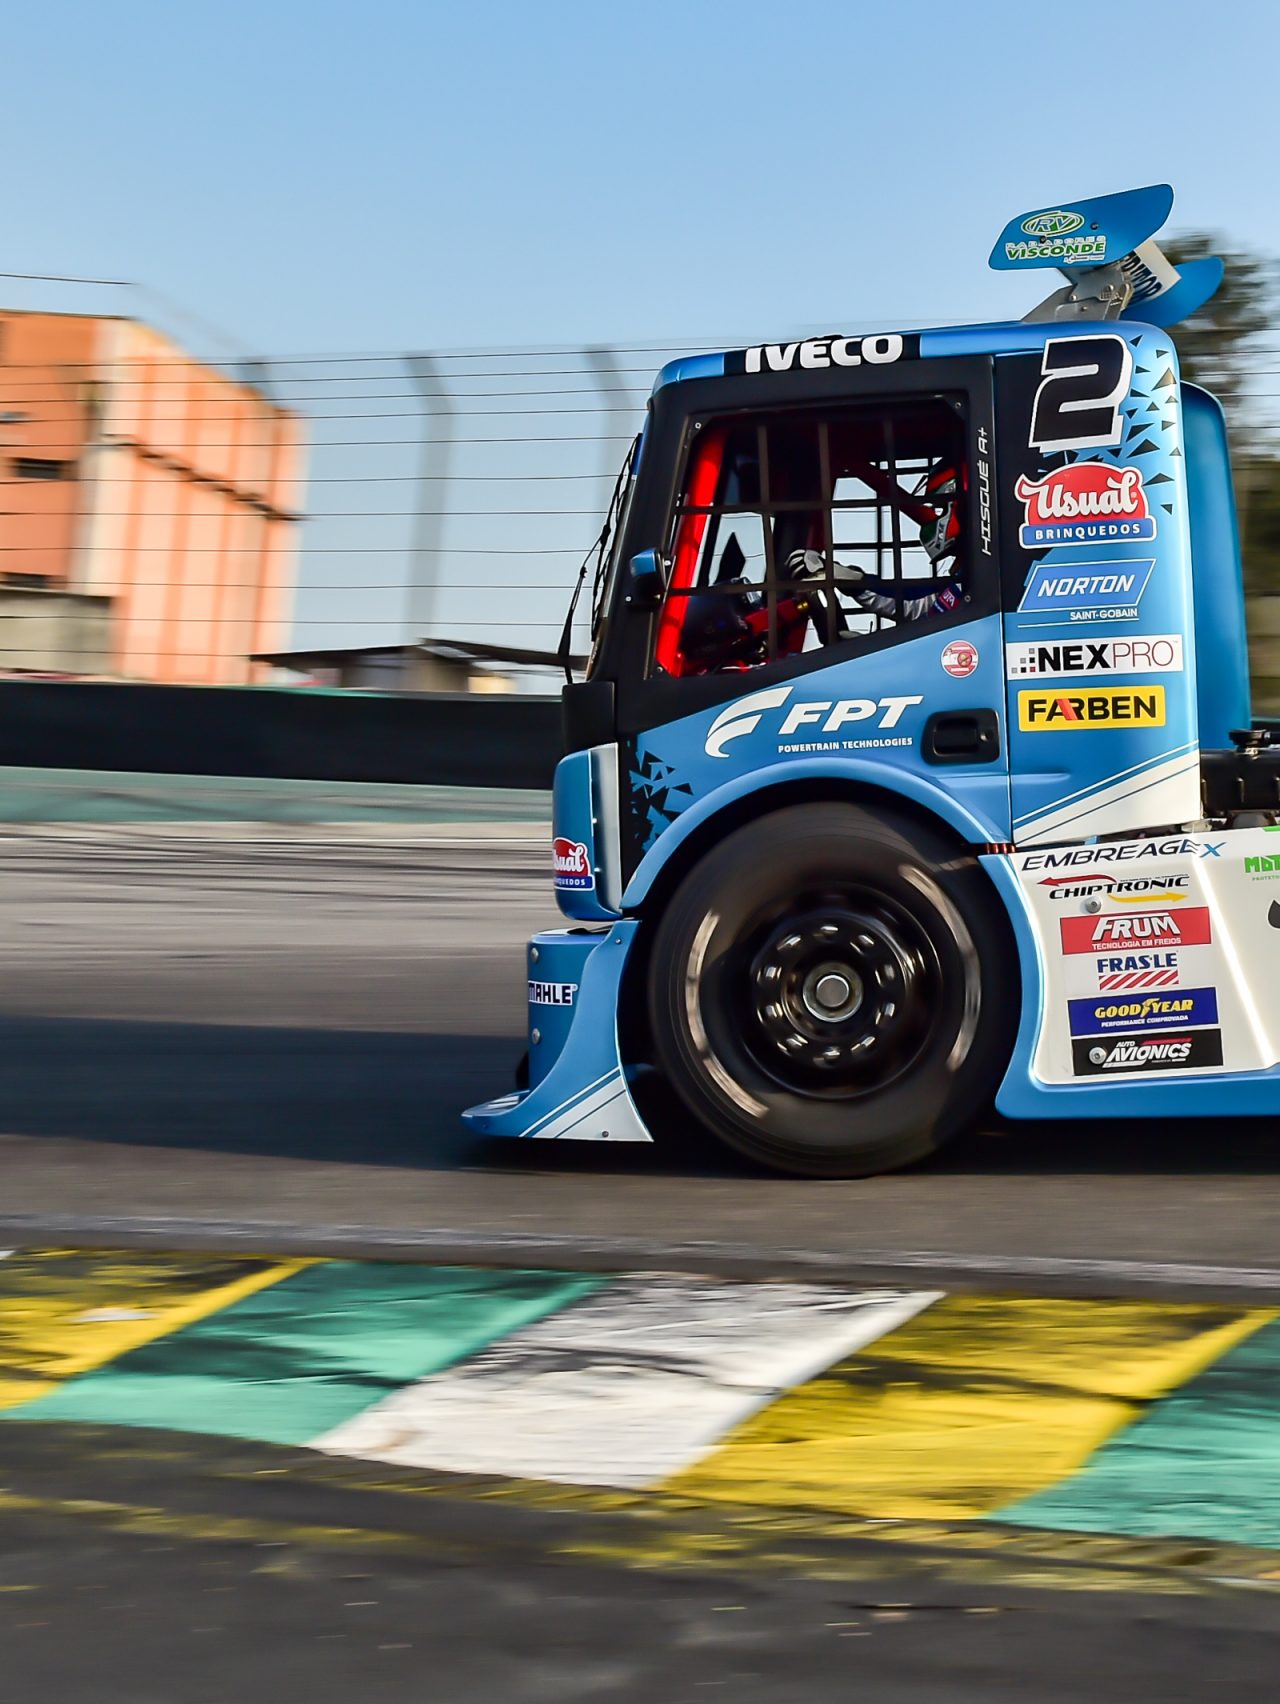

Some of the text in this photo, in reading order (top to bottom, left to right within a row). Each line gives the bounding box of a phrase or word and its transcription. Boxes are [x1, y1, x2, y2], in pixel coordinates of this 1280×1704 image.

[1007, 242, 1105, 259] VISCONDE
[745, 334, 903, 373] IVECO
[1028, 334, 1133, 453] 2
[1021, 471, 1138, 518] Usual
[1035, 523, 1141, 540] BRINQUEDOS
[1037, 574, 1136, 597] NORTON
[1070, 608, 1138, 621] SAINT-GOBAIN
[778, 695, 924, 735] FPT
[1028, 695, 1156, 722] FARBEN
[778, 737, 913, 753] POWERTRAIN TECHNOLOGIES
[1049, 876, 1190, 900] CHIPTRONIC
[1091, 912, 1181, 942] FRUM
[1092, 937, 1182, 951] TECNOLOGIA EM FREIOS
[1094, 998, 1194, 1018] GOODYEAR
[1105, 1043, 1192, 1063] AVIONICS
[1116, 1040, 1136, 1048] AUTO
